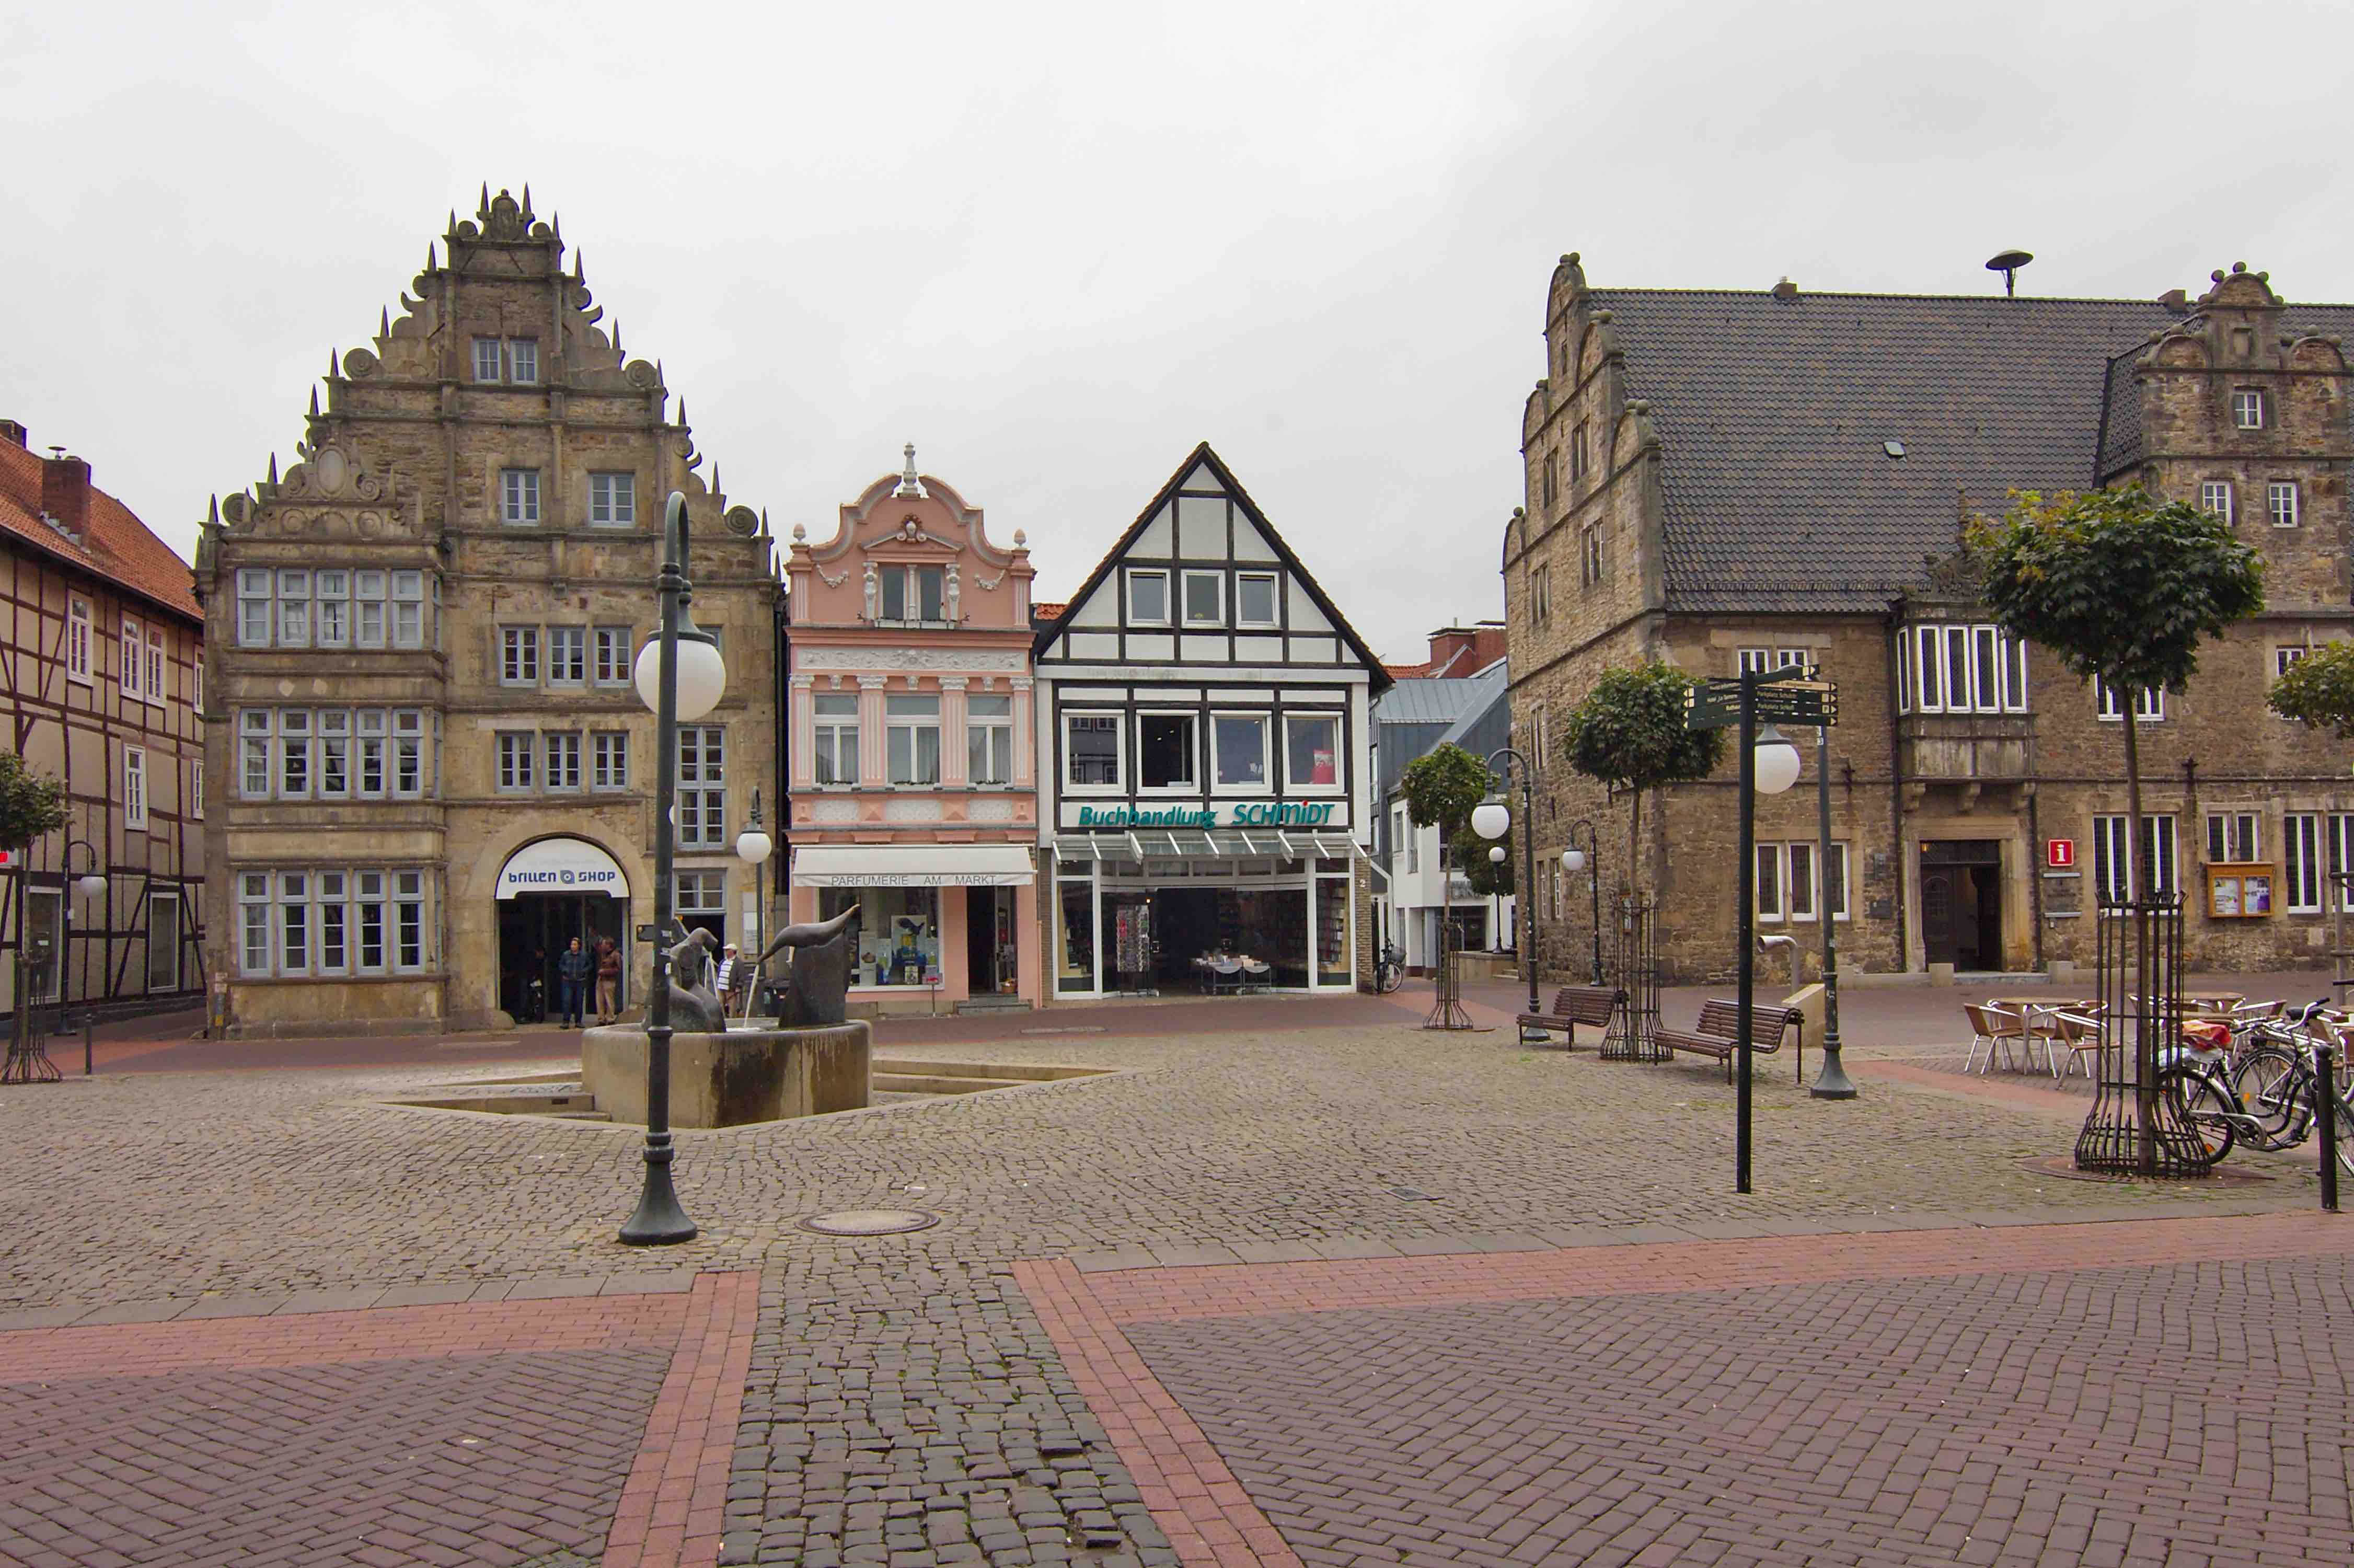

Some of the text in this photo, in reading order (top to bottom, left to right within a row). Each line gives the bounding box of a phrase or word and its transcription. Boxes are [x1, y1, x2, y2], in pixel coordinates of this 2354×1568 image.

[1079, 806, 1218, 829] Buchhandlung
[578, 871, 616, 882] SHOP
[924, 875, 941, 884] AM
[955, 874, 995, 884] MARKT
